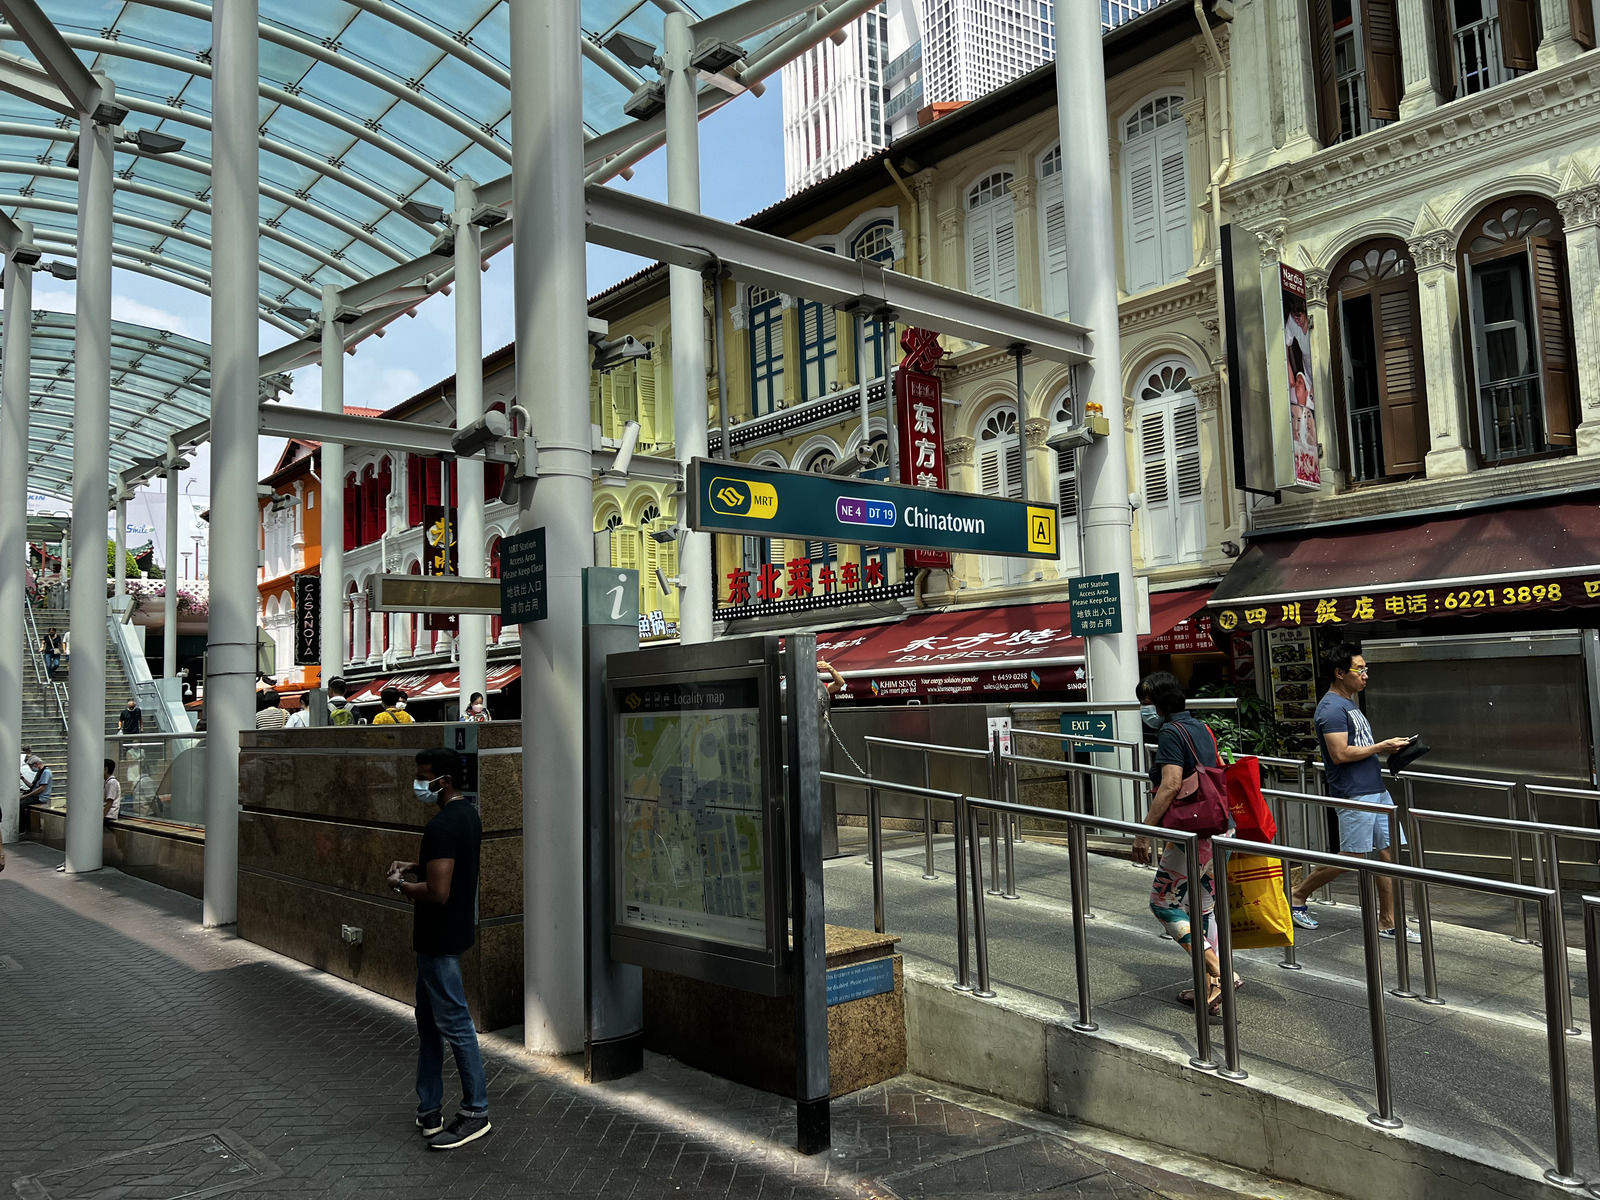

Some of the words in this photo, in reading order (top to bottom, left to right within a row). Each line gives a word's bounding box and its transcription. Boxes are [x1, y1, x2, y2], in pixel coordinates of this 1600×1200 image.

[1282, 267, 1303, 287] Nardia
[911, 380, 935, 399] BBQ
[754, 495, 774, 507] MRT
[841, 504, 853, 516] NE
[855, 506, 862, 517] 4
[868, 507, 881, 519] DT
[882, 509, 894, 521] 19
[904, 506, 986, 535] Chinatown
[1036, 521, 1047, 540] A
[126, 524, 149, 534] Smile
[508, 543, 519, 554] MRT
[519, 540, 537, 552] Station
[509, 555, 525, 566] Access
[525, 553, 536, 562] Area
[502, 570, 518, 580] Please
[518, 567, 531, 577] Keep
[530, 563, 544, 574] Clear
[506, 580, 542, 598] 地铁出入口
[1078, 582, 1089, 590] MRT
[1090, 580, 1109, 589] Station
[1079, 590, 1096, 598] Access
[1096, 588, 1109, 596] Area
[1103, 595, 1118, 603] Clear
[510, 597, 539, 615] 请勿占用
[1222, 614, 1234, 626] 72
[1244, 595, 1376, 625] 四川飯店
[1444, 589, 1496, 610] 6221
[1502, 583, 1563, 606] 3898
[1076, 606, 1116, 619] 地铁出入口
[302, 583, 315, 656] CASANOVA
[1081, 618, 1113, 630] 请勿占用
[888, 628, 1085, 655] 东方烧
[895, 646, 1050, 664] BARBECUE
[930, 677, 943, 685] energy
[943, 676, 961, 684] solutions
[961, 675, 979, 684] provider
[1012, 672, 1028, 680] 0288
[880, 680, 898, 689] KHIM
[898, 679, 917, 688] SENG
[983, 682, 1029, 691] sales@ksg.com.sg
[880, 688, 889, 696] gas
[900, 687, 909, 695] pte
[673, 691, 703, 707] Locality
[706, 692, 725, 706] map
[1071, 720, 1090, 731] EXIT
[457, 731, 464, 746] A
